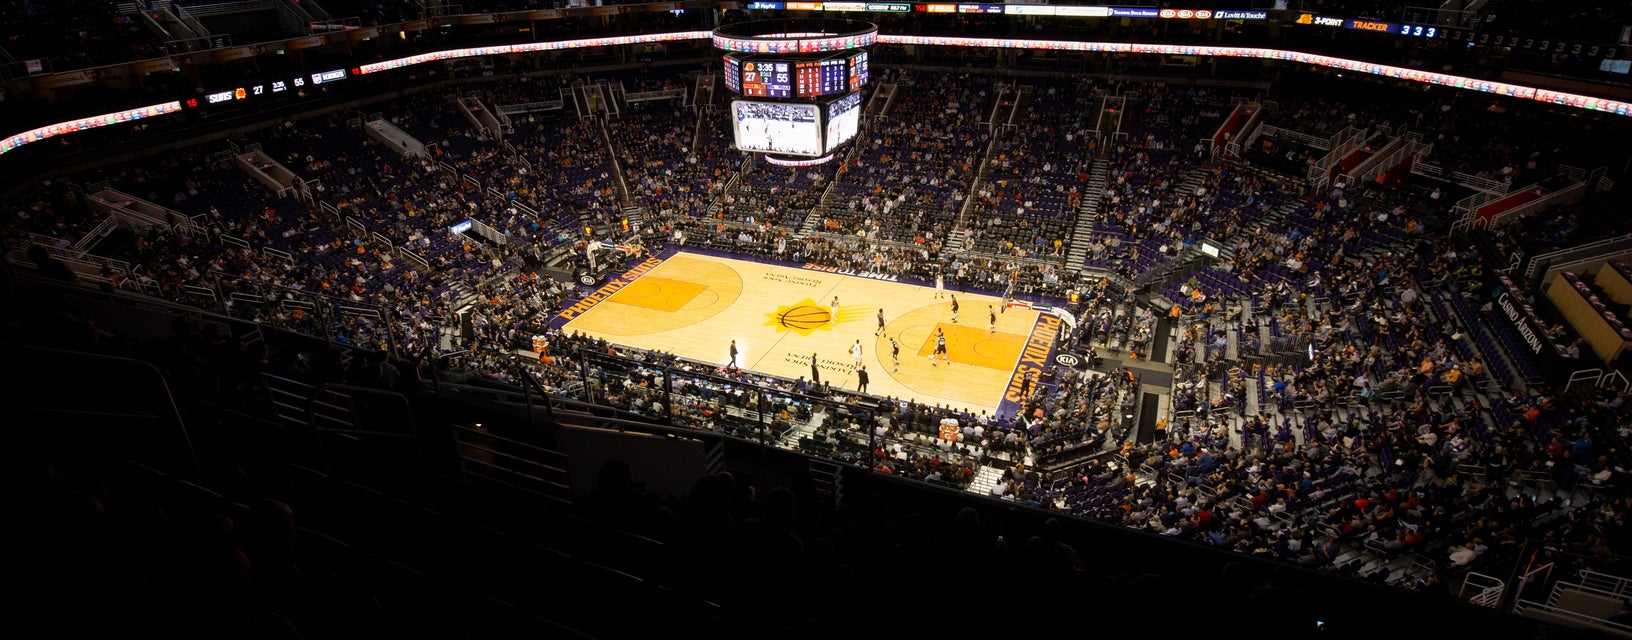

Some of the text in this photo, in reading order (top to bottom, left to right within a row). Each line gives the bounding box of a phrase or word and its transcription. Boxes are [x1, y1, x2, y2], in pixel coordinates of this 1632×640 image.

[1314, 16, 1343, 26] 3-POINT
[1353, 21, 1388, 31] TRACKER
[1401, 25, 1410, 34] 3
[1414, 26, 1422, 36] 3
[1426, 28, 1435, 37] 3
[745, 72, 756, 81] 27
[777, 73, 788, 82] 55
[209, 92, 232, 103] SUNS
[253, 86, 263, 94] 27
[294, 78, 304, 86] 55
[187, 99, 197, 107] 15
[802, 263, 839, 272] RISE
[857, 270, 898, 282] TIME
[560, 257, 662, 320] PHOENIX SUNS
[1498, 292, 1542, 354] CASINO ARIZONA
[1021, 315, 1061, 368] PHOENIX
[1005, 364, 1042, 406] SUNS
